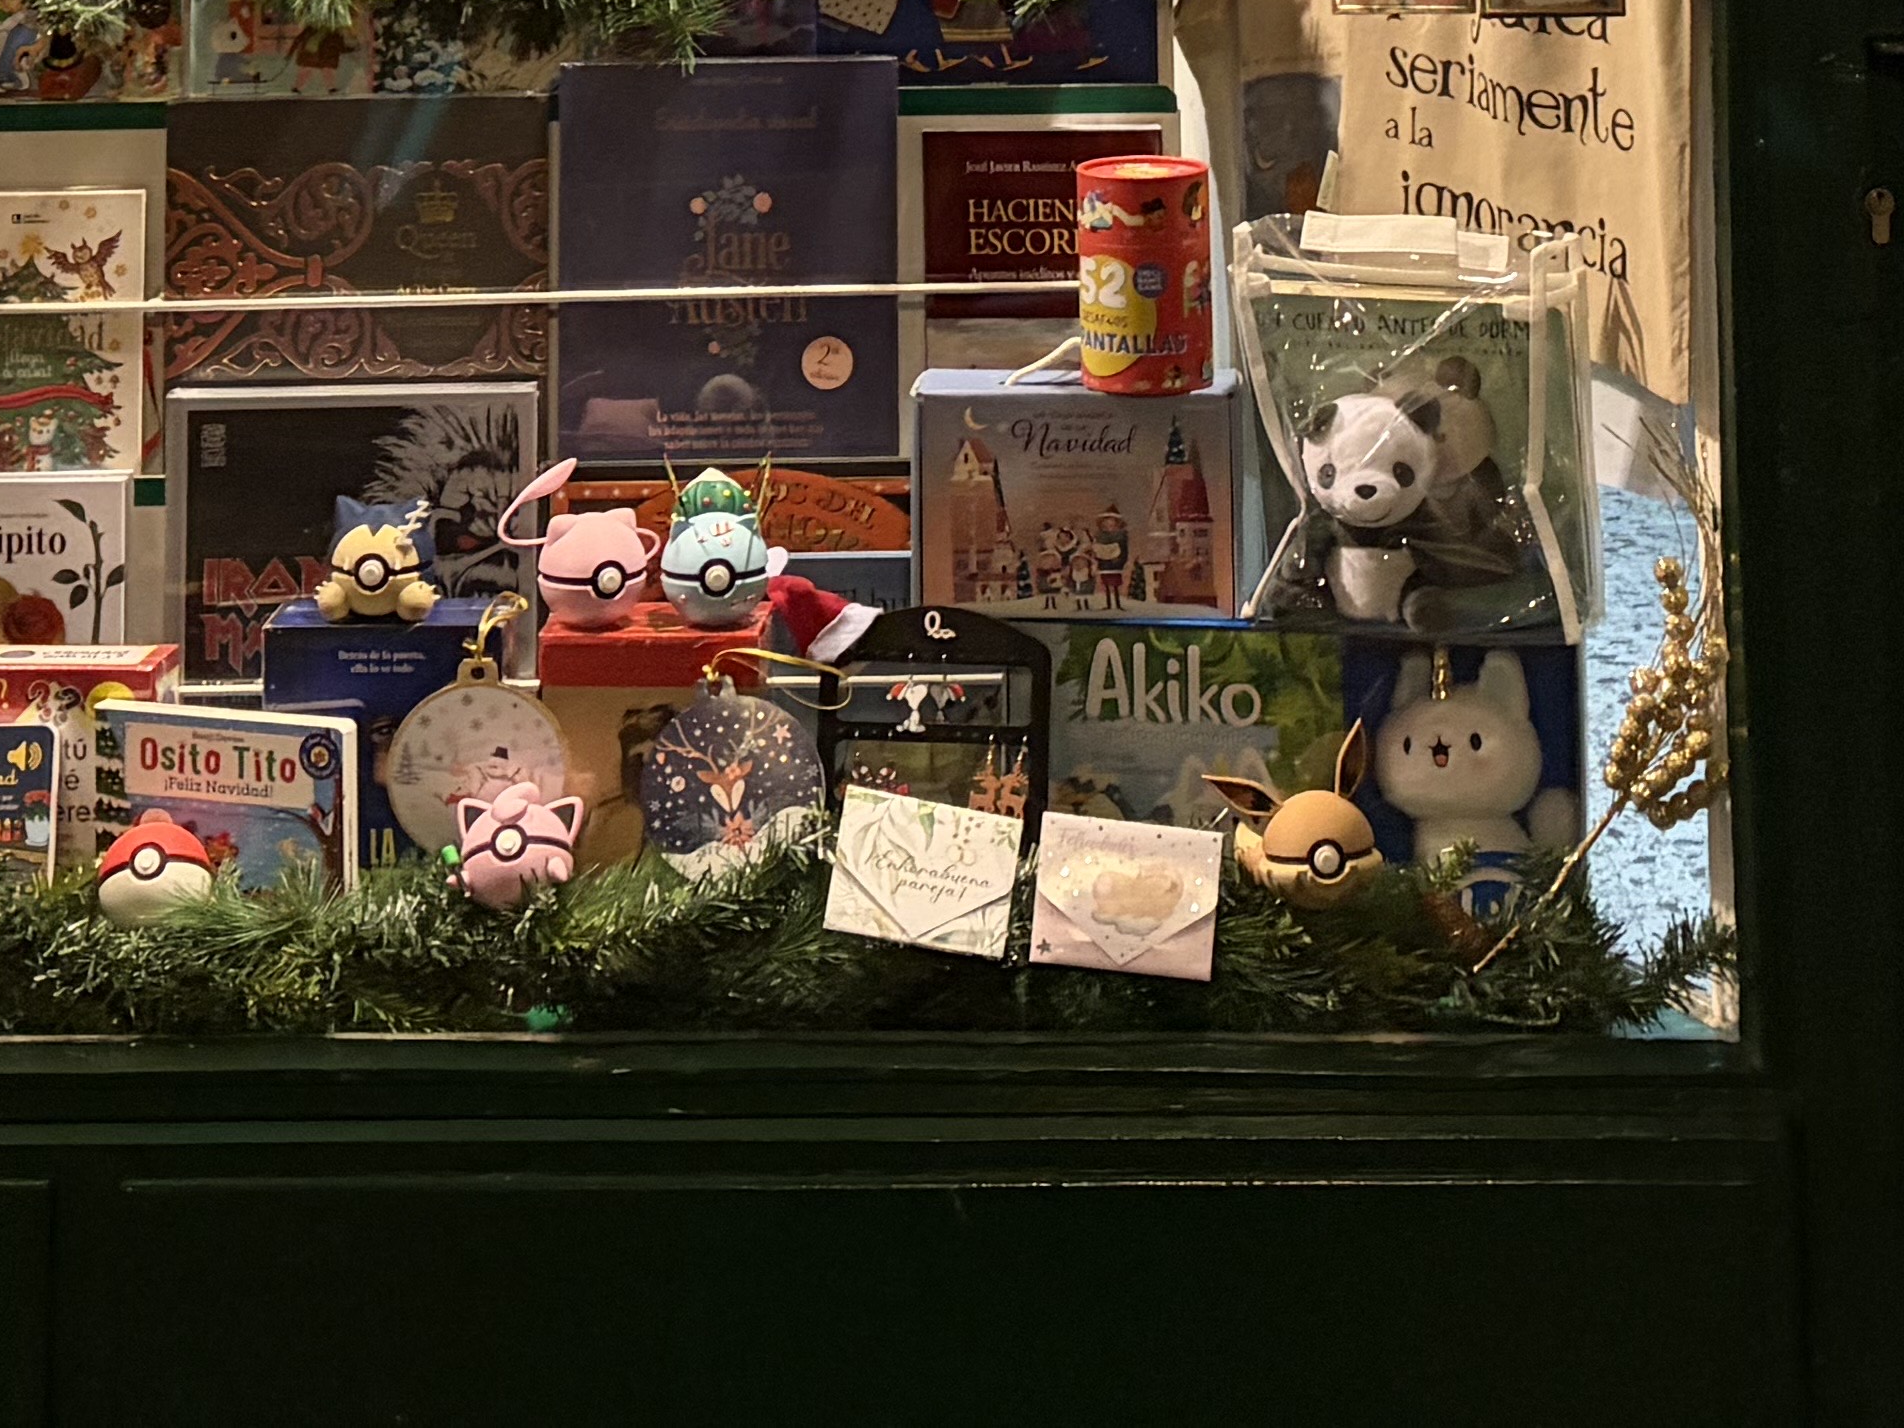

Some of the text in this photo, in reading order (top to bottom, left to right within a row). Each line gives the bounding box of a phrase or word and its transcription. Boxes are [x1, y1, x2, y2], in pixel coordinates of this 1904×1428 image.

[1385, 46, 1634, 151] seriamente
[1385, 107, 1433, 147] a la
[1085, 638, 1262, 727] Akiko
[140, 737, 295, 783] Osito Tito
[164, 777, 273, 798] ¡Feliz Navidad!
